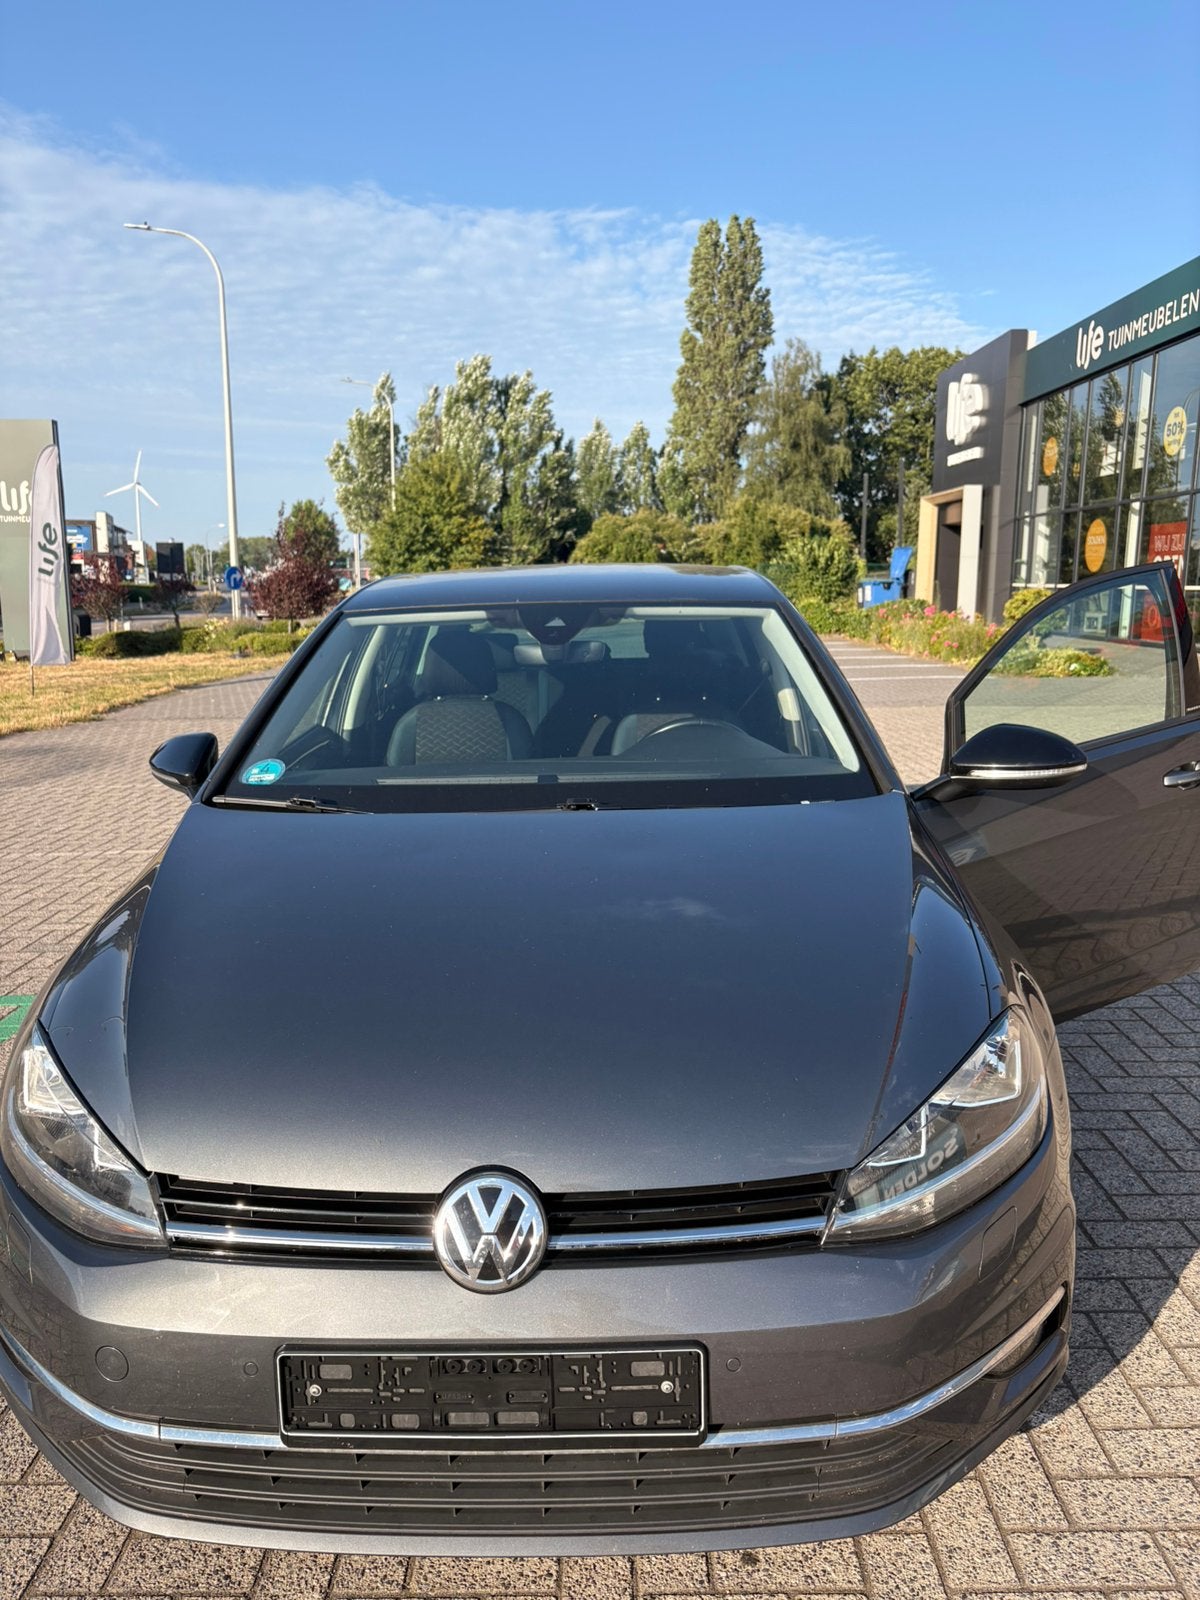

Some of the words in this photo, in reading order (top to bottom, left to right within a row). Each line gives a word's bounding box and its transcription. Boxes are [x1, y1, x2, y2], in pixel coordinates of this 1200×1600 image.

[1076, 320, 1104, 370] life
[1108, 289, 1200, 351] TUINMEUBELEN
[1166, 421, 1185, 438] 50%
[0, 480, 32, 515] lif
[0, 515, 31, 523] TUINMEU
[38, 522, 59, 576] life
